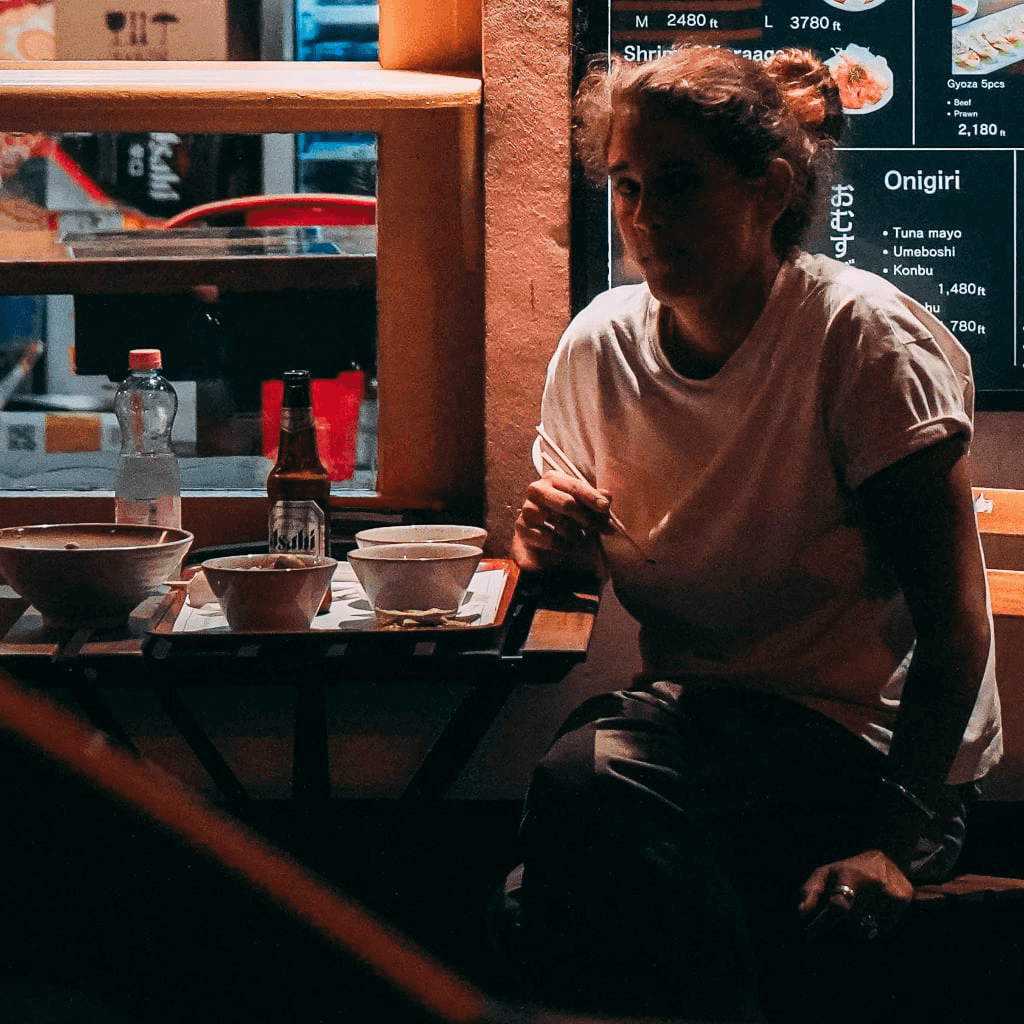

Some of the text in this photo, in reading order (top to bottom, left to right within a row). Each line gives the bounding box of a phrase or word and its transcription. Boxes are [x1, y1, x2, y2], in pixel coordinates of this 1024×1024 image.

[668, 14, 706, 26] 2480
[790, 16, 829, 29] 3780
[947, 79, 1005, 90] Gyoza 5pcs
[958, 124, 997, 136] 2,180
[885, 170, 960, 194] Onigiri
[893, 227, 961, 240] Tuna mayo
[894, 246, 955, 257] Umeboshi
[894, 264, 933, 275] Konbu
